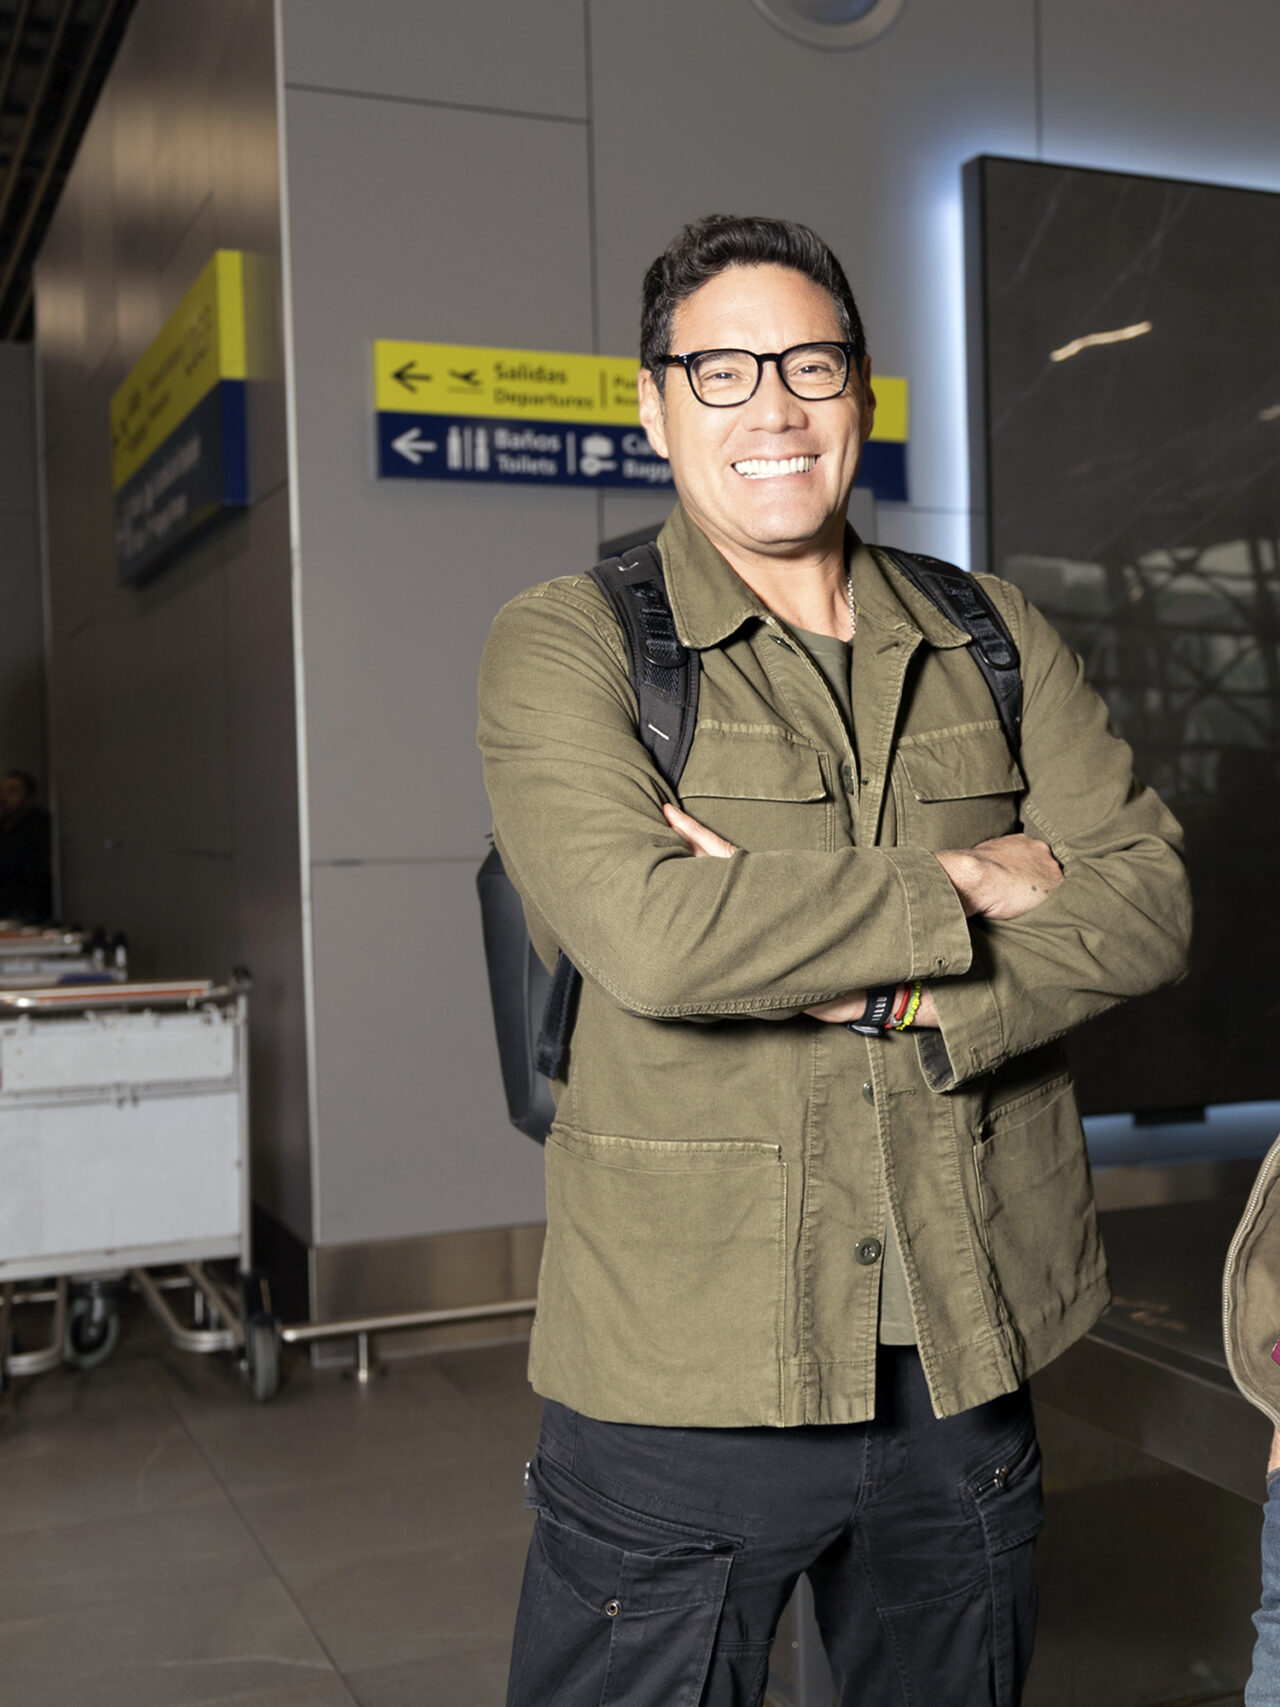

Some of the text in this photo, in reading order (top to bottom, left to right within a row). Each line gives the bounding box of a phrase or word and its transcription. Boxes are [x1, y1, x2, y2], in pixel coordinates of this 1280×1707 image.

[493, 361, 567, 384] Salidas
[493, 389, 594, 409] Departures
[493, 428, 562, 453] Baños
[495, 452, 559, 477] Toilets
